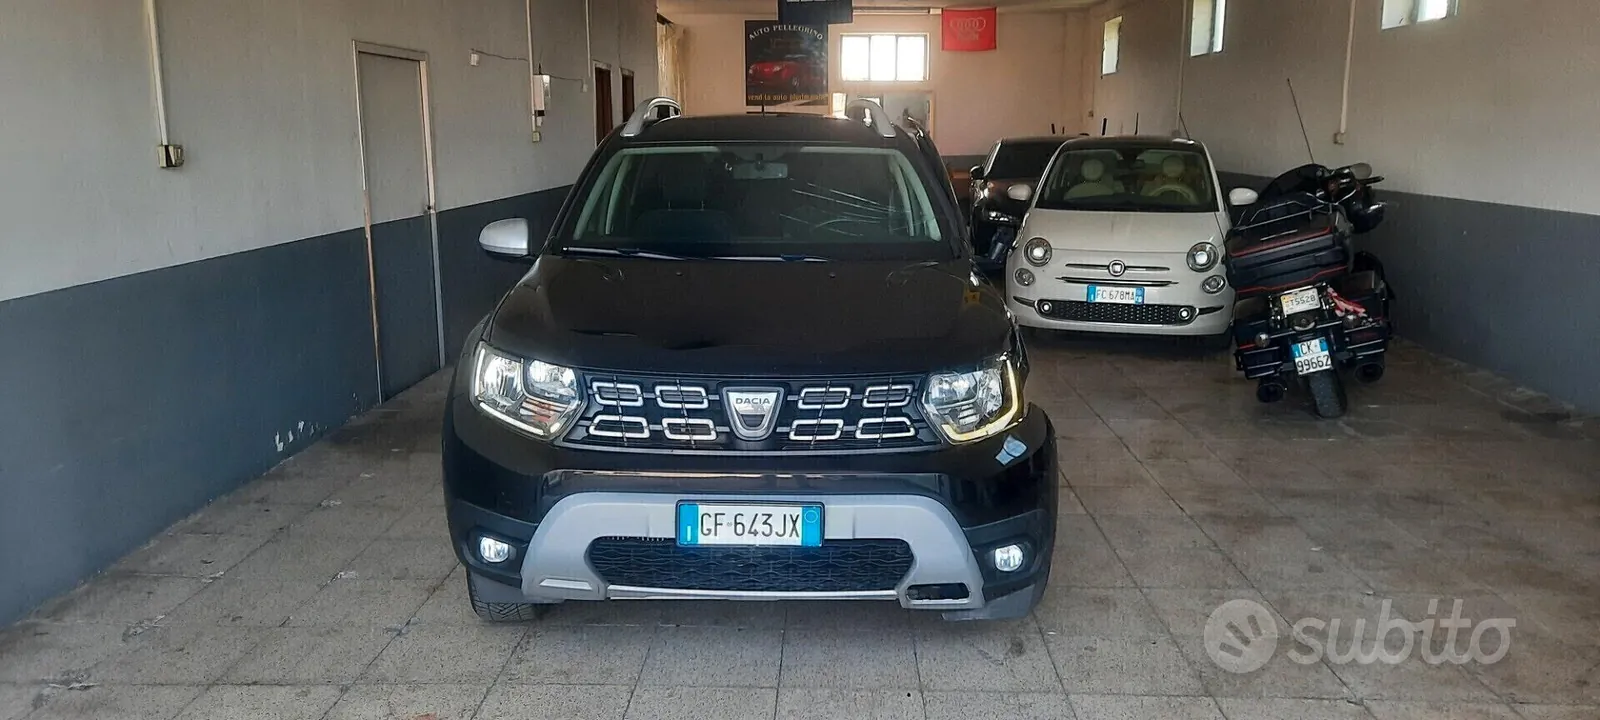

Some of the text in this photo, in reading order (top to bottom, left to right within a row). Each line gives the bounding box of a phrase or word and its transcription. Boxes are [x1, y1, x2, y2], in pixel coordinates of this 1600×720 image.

[749, 24, 823, 40] AUTO PELLEGRINO
[773, 93, 788, 101] auto
[1096, 289, 1107, 299] FC
[1300, 341, 1315, 355] CK
[1297, 354, 1331, 372] 99662
[735, 397, 771, 405] DACIA
[700, 512, 800, 538] GF 643JX
